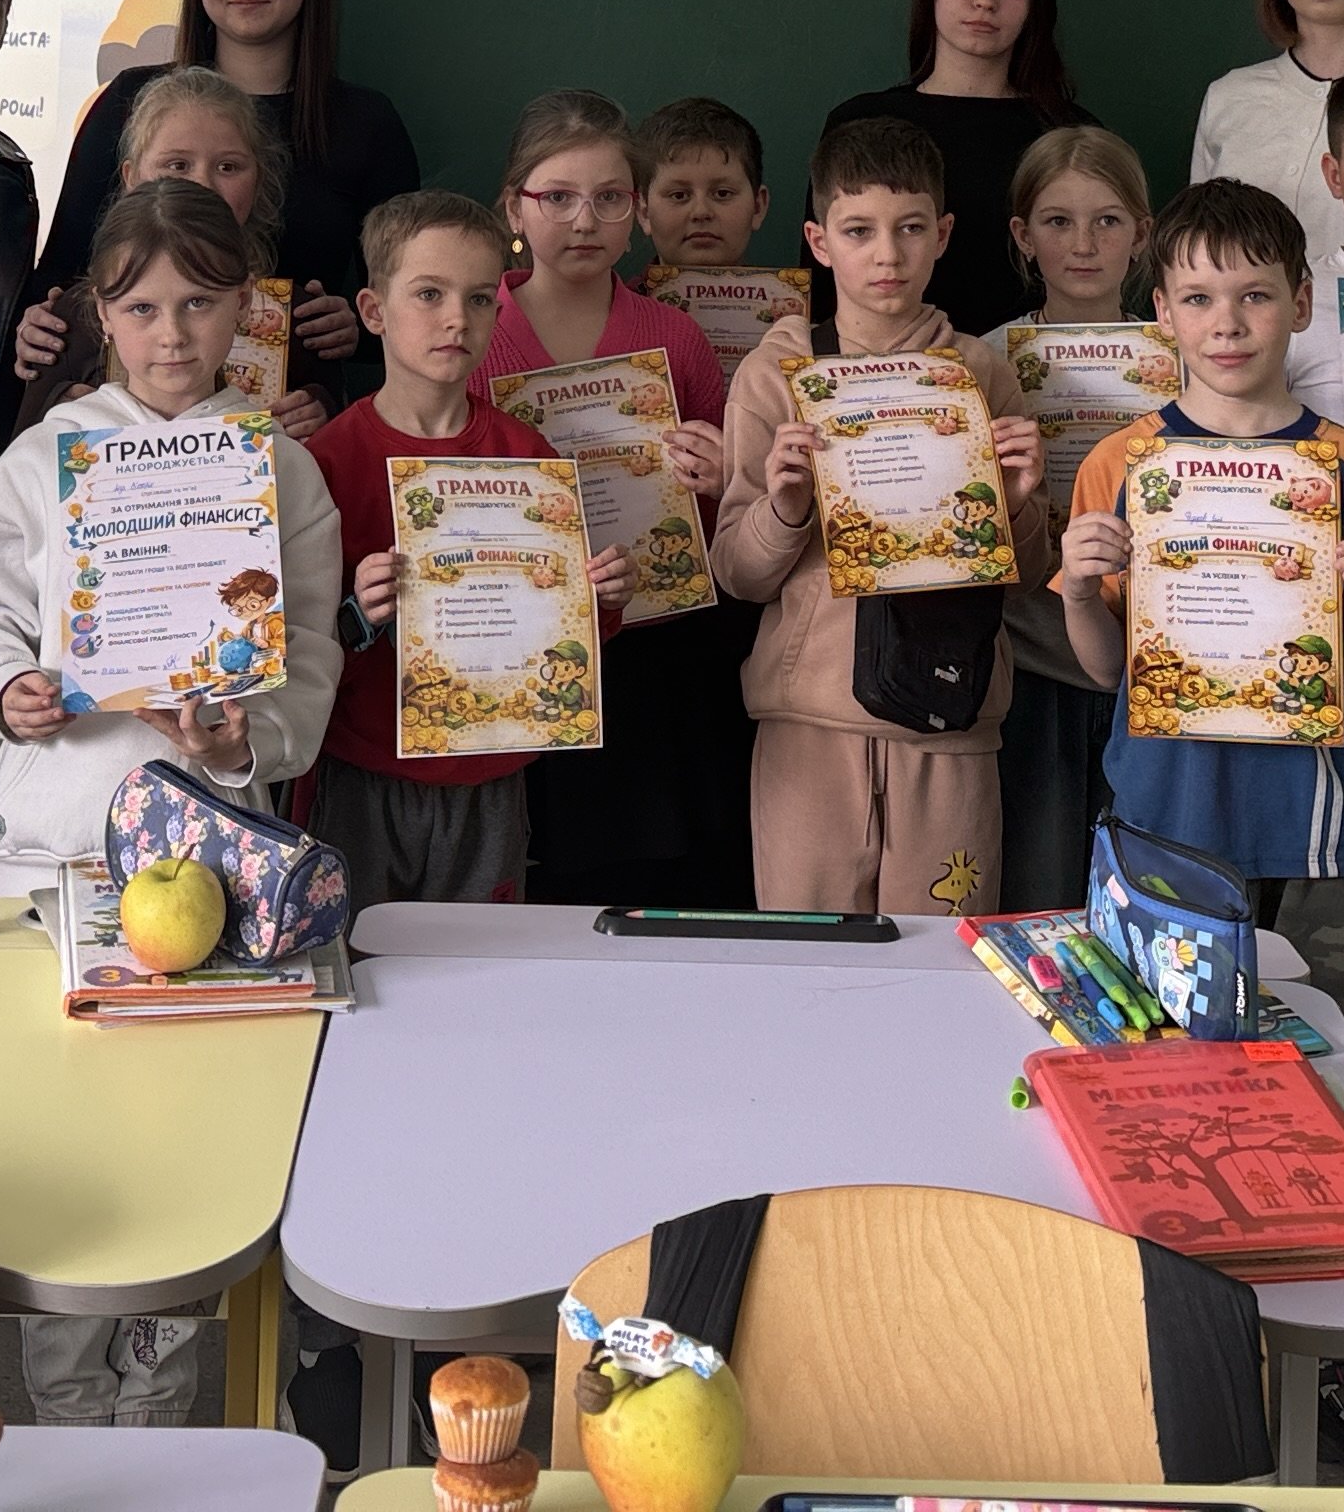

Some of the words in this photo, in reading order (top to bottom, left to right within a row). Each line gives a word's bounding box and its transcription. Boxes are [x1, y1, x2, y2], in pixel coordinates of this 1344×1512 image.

[686, 285, 767, 301] ГРАМОТА
[1044, 344, 1134, 360] ГРАМОТА
[827, 360, 922, 379] ГРАМОТА
[536, 377, 625, 407] ГРАМОТА
[835, 409, 875, 427] ЮНИЙ
[877, 406, 949, 419] ФІНАНСИСТ
[1038, 408, 1074, 425] ЮНИЙ
[105, 431, 235, 463] ГРАМОТА
[577, 444, 645, 461] ФІНАНСИСТ
[115, 454, 225, 474] НАГОРОДЖУЄТЬСЯ
[1176, 461, 1283, 481] ГРАМОТА
[437, 479, 532, 496] ГРАМОТА
[110, 505, 122, 514] ЗА
[124, 499, 182, 512] ОТРИМАННЯ
[184, 494, 222, 506] ЗВАННЯ
[83, 512, 176, 540] МОЛОДШИЙ
[179, 507, 263, 528] ФІНАНСИСТ
[104, 549, 117, 560] ЗА
[121, 544, 171, 558] ВМІННЯ:
[1165, 536, 1210, 554] ЮНИЙ
[1212, 538, 1295, 557] ФІНАНСИСТ
[433, 548, 474, 568] ЮНИЙ
[476, 549, 550, 566] ФІНАНСИСТ
[99, 968, 121, 983] 3
[1086, 1076, 1286, 1104] МАТЕМАТИКА
[1158, 1216, 1186, 1235] 3
[612, 1329, 651, 1346] MILKY
[611, 1340, 656, 1362] SPLASH
